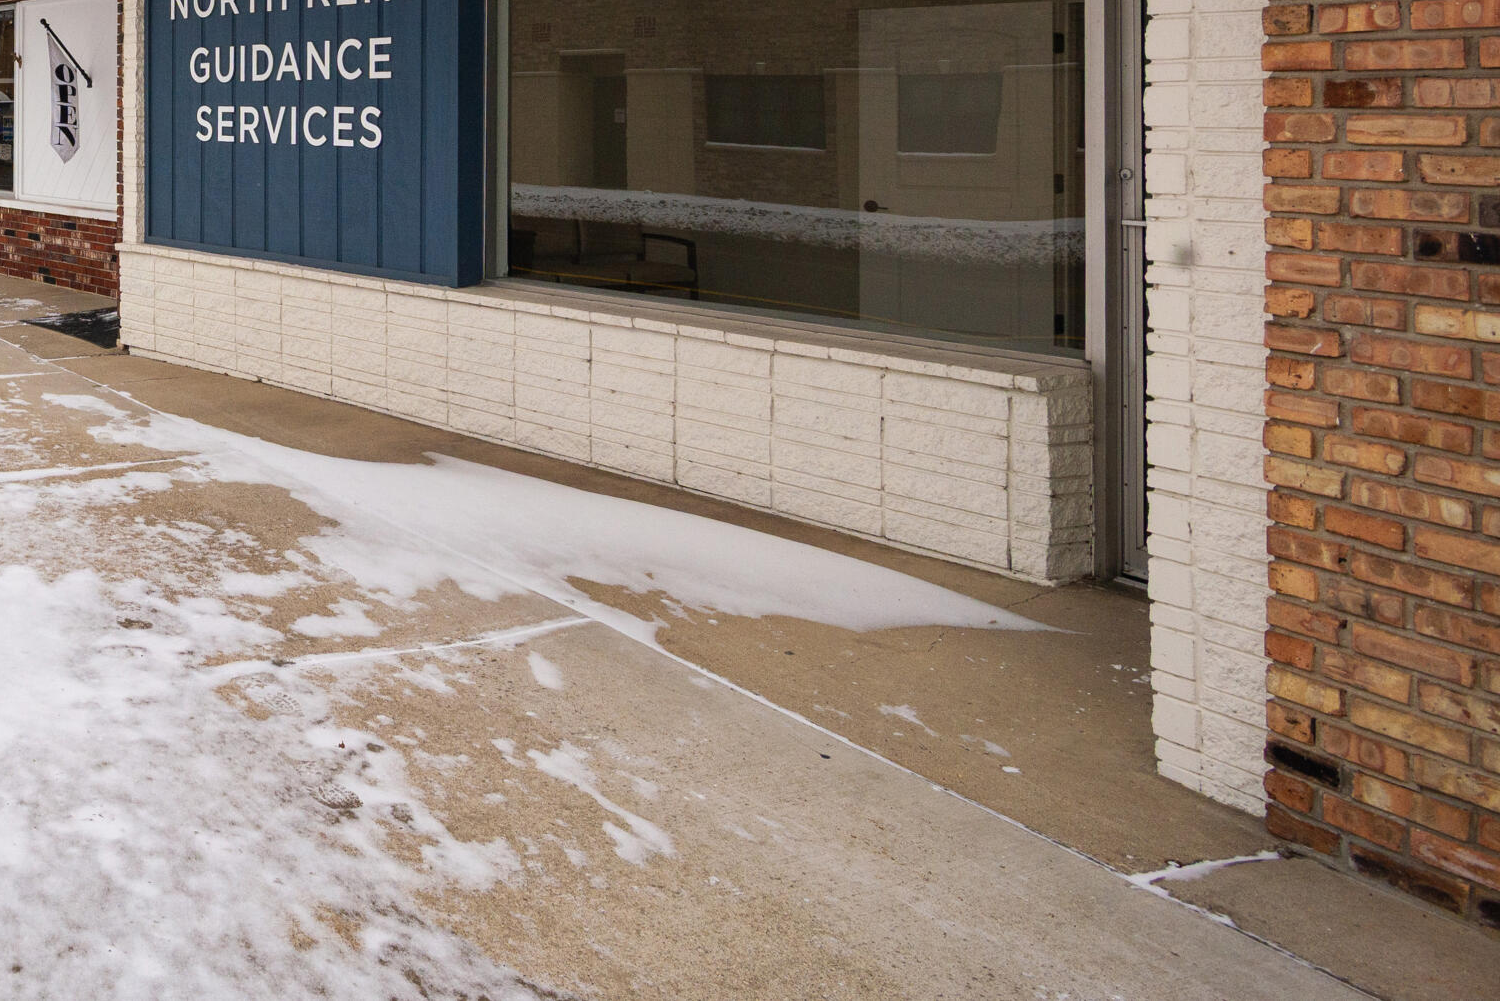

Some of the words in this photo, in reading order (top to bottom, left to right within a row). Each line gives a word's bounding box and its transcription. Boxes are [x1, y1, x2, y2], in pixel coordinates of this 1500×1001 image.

[189, 37, 393, 83] GUIDANCE
[54, 64, 78, 147] OPEN
[195, 105, 382, 149] SERVICES
